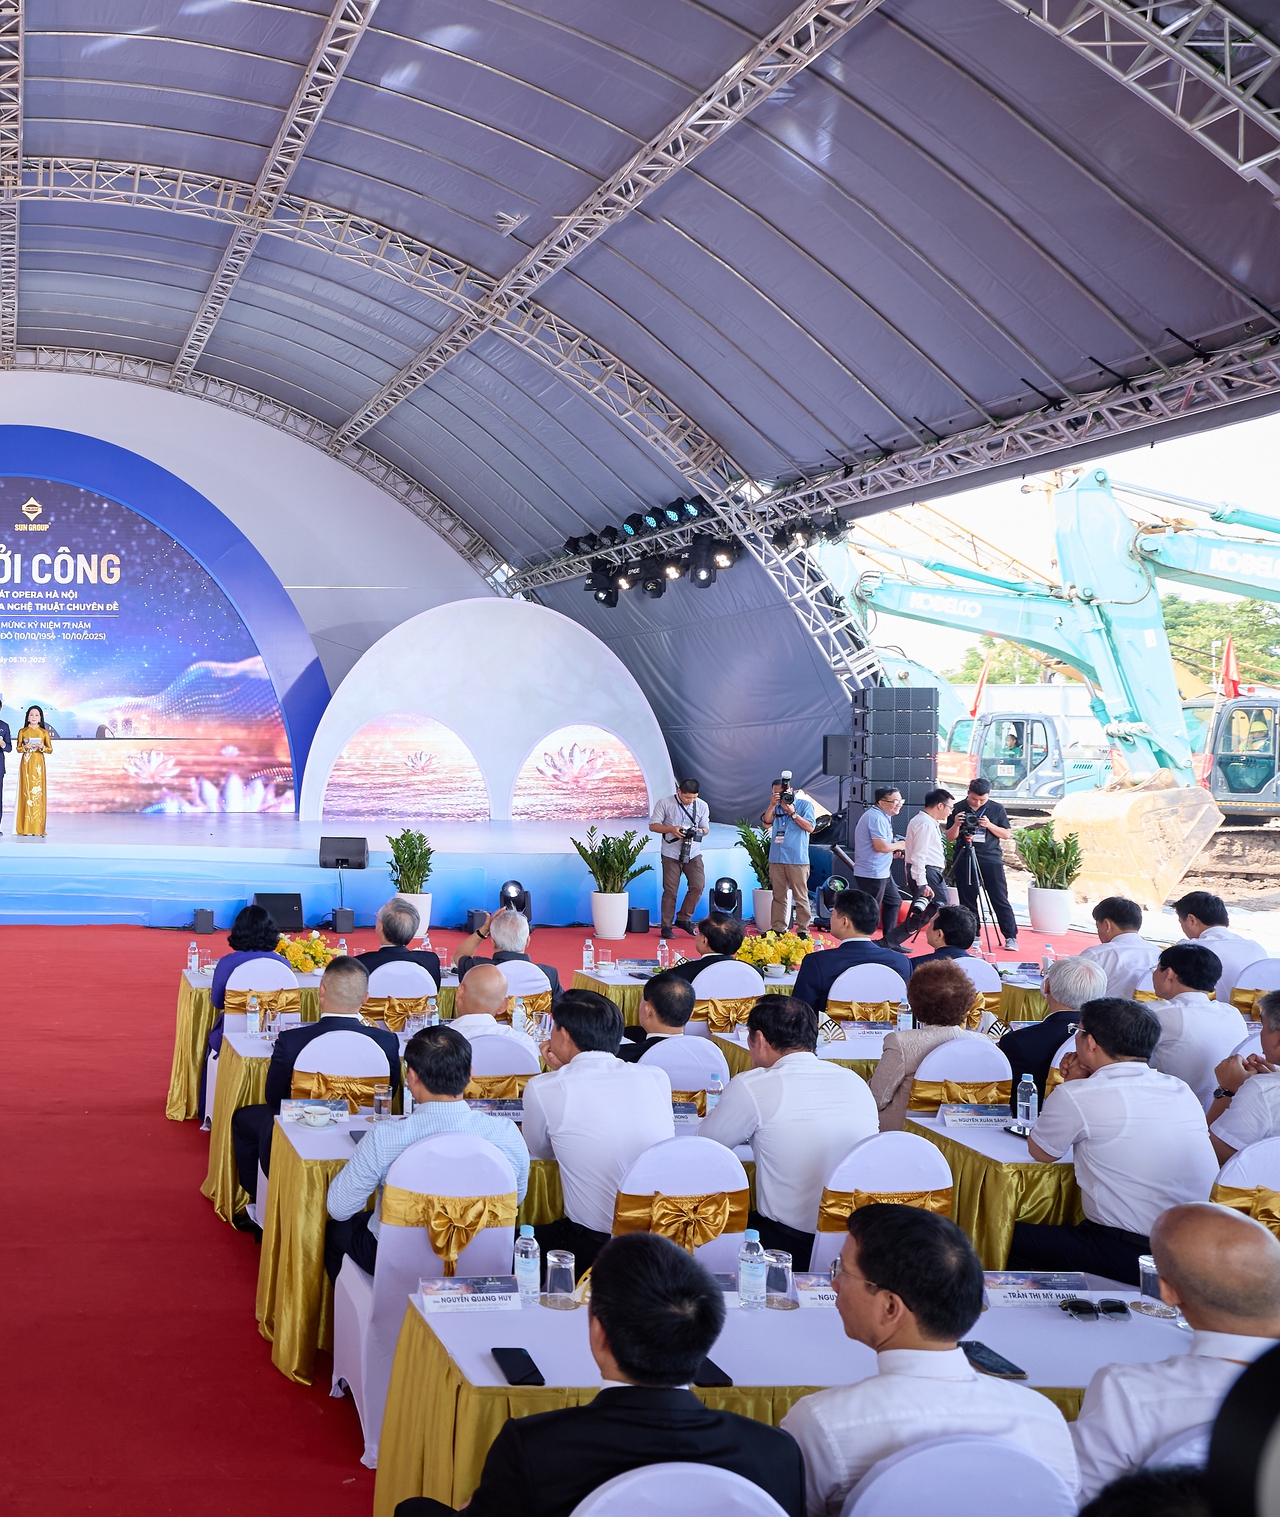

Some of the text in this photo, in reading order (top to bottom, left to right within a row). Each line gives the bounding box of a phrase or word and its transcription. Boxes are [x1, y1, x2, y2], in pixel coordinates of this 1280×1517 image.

[14, 524, 27, 532] SUN
[32, 546, 121, 585] CÔNG
[12, 591, 44, 599] OPERA
[45, 590, 60, 599] HÀ
[61, 590, 78, 601] NỘI
[7, 602, 33, 613] NGHỆ
[35, 602, 65, 613] THUẬT
[66, 602, 104, 611] CHUYÊN
[106, 601, 119, 611] ĐỀ
[909, 592, 982, 618] KOBELCO
[1, 620, 26, 629] MỪNG
[40, 621, 61, 631] NIỆM
[62, 621, 71, 629] 71
[72, 621, 91, 630] NĂM
[0, 631, 13, 640] ĐÔ
[440, 1294, 470, 1303] NGUYỄN
[471, 1294, 497, 1303] QUANG
[498, 1294, 512, 1302] HUY
[1007, 1290, 1028, 1299] TRẦN
[1028, 1292, 1042, 1300] THỊ
